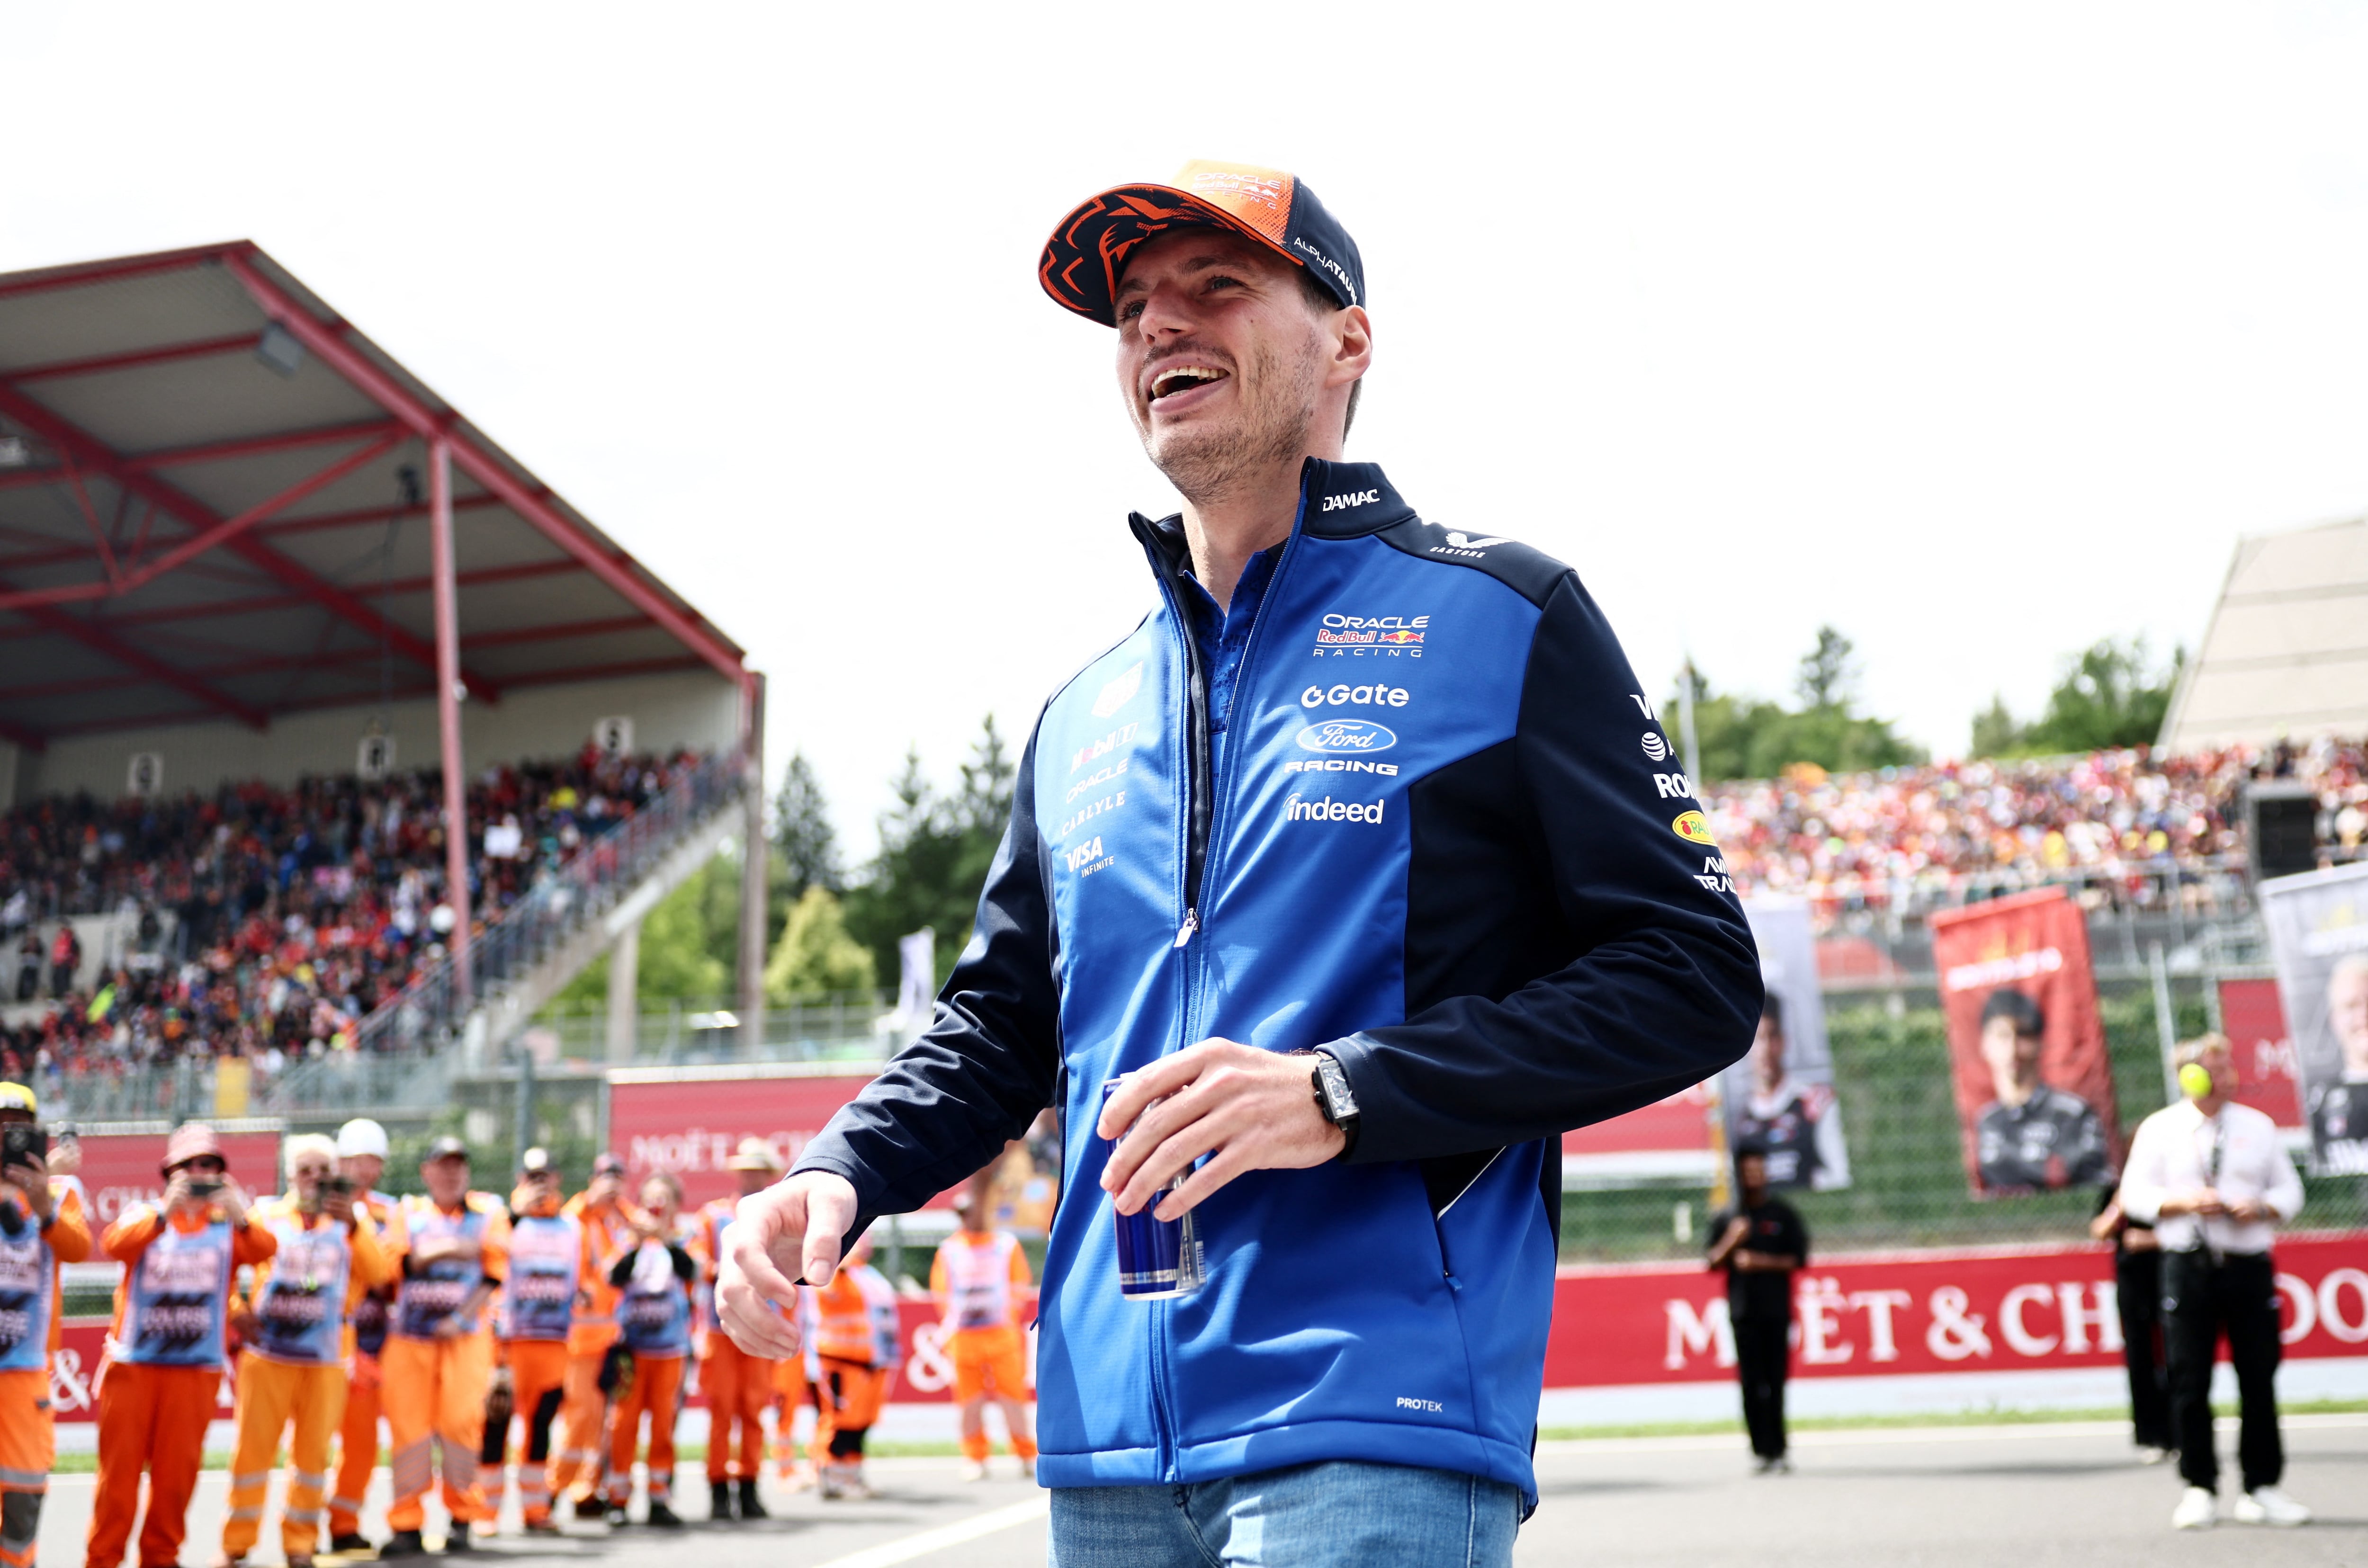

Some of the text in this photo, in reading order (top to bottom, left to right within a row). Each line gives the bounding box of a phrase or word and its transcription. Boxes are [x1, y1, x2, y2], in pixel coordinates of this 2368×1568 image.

[1194, 173, 1281, 189] ORACLE
[1322, 489, 1380, 512] DAMAC
[1430, 547, 1486, 558] CASTORE
[1322, 614, 1430, 629] ORACLE
[1313, 648, 1422, 658] RACING
[1314, 724, 1377, 748] Ford
[1070, 731, 1116, 775] Mobil
[1283, 760, 1399, 777] RACING
[1066, 758, 1129, 804] ORACLE
[1061, 790, 1126, 836] CARLYLE
[1283, 793, 1384, 824] indeed
[1064, 835, 1103, 873] VISA
[1081, 855, 1114, 878] INFINITE
[1663, 1275, 1913, 1371] MËT
[1926, 1285, 1993, 1361] &
[50, 1348, 91, 1412] &
[1396, 1397, 1443, 1413] PROTEK
